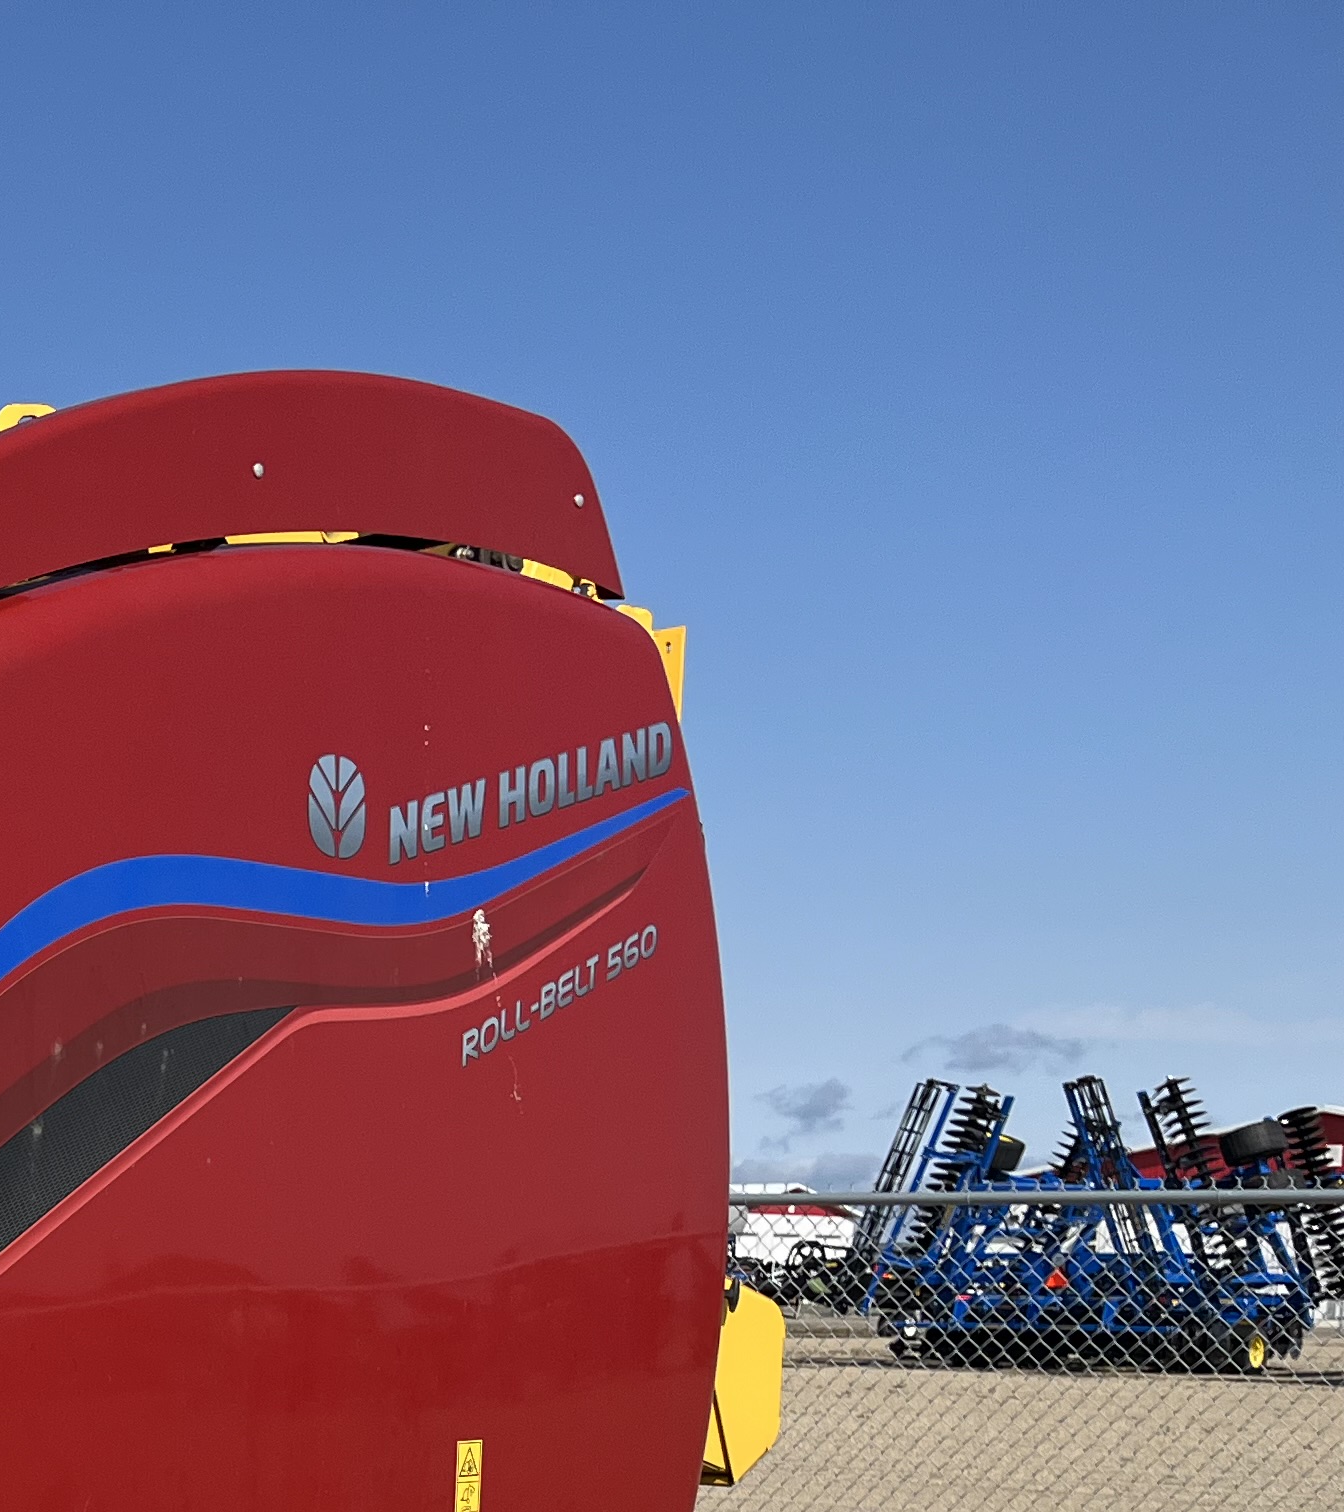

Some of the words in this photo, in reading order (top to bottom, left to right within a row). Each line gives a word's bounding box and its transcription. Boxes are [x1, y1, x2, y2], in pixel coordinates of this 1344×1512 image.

[388, 778, 487, 865] NEW
[498, 721, 672, 828] HOLLAND
[461, 954, 599, 1067] ROLL-BELT
[605, 924, 658, 981] 560
